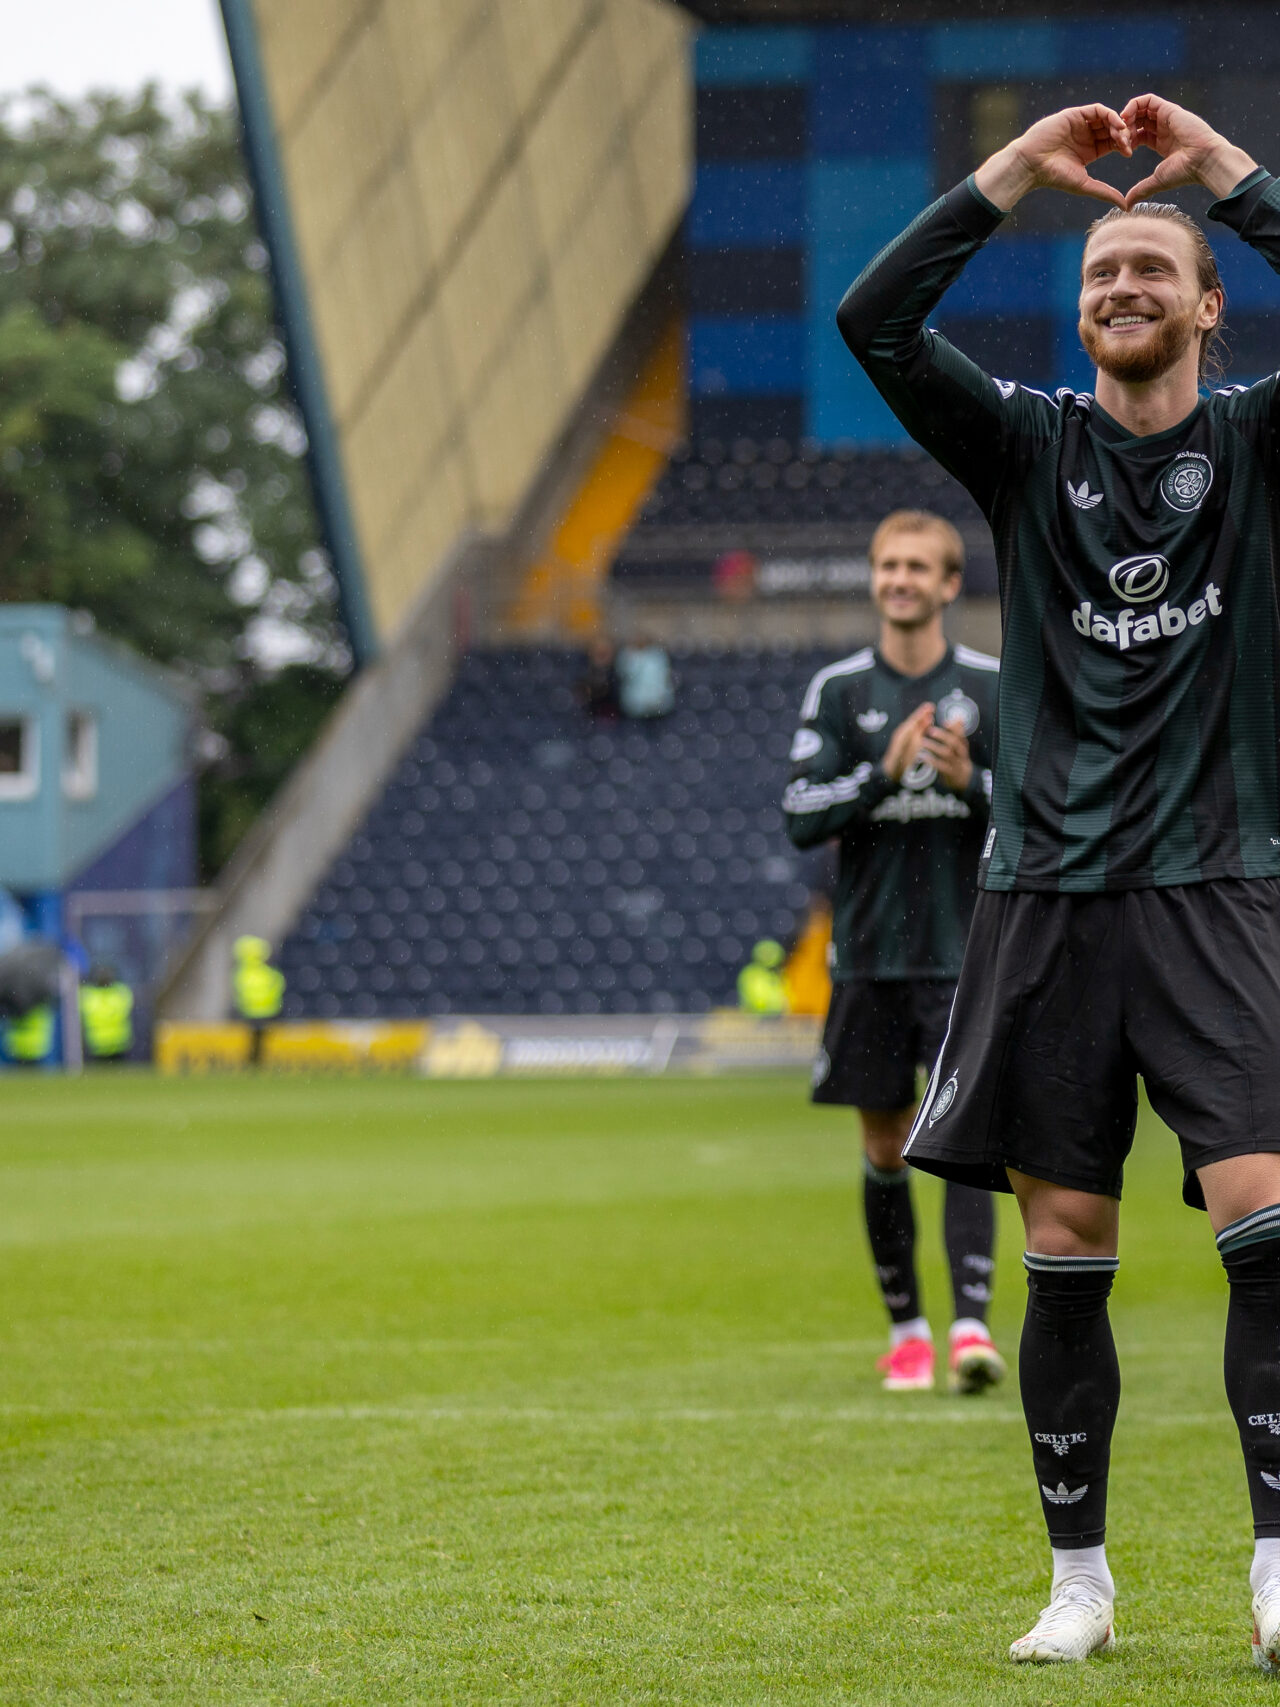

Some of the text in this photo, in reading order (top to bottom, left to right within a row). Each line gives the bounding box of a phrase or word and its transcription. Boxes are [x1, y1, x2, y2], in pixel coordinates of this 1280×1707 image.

[1176, 463, 1198, 473] FOOTBALL
[1072, 582, 1223, 650] dafabet
[1034, 1432, 1087, 1445] CELTIC
